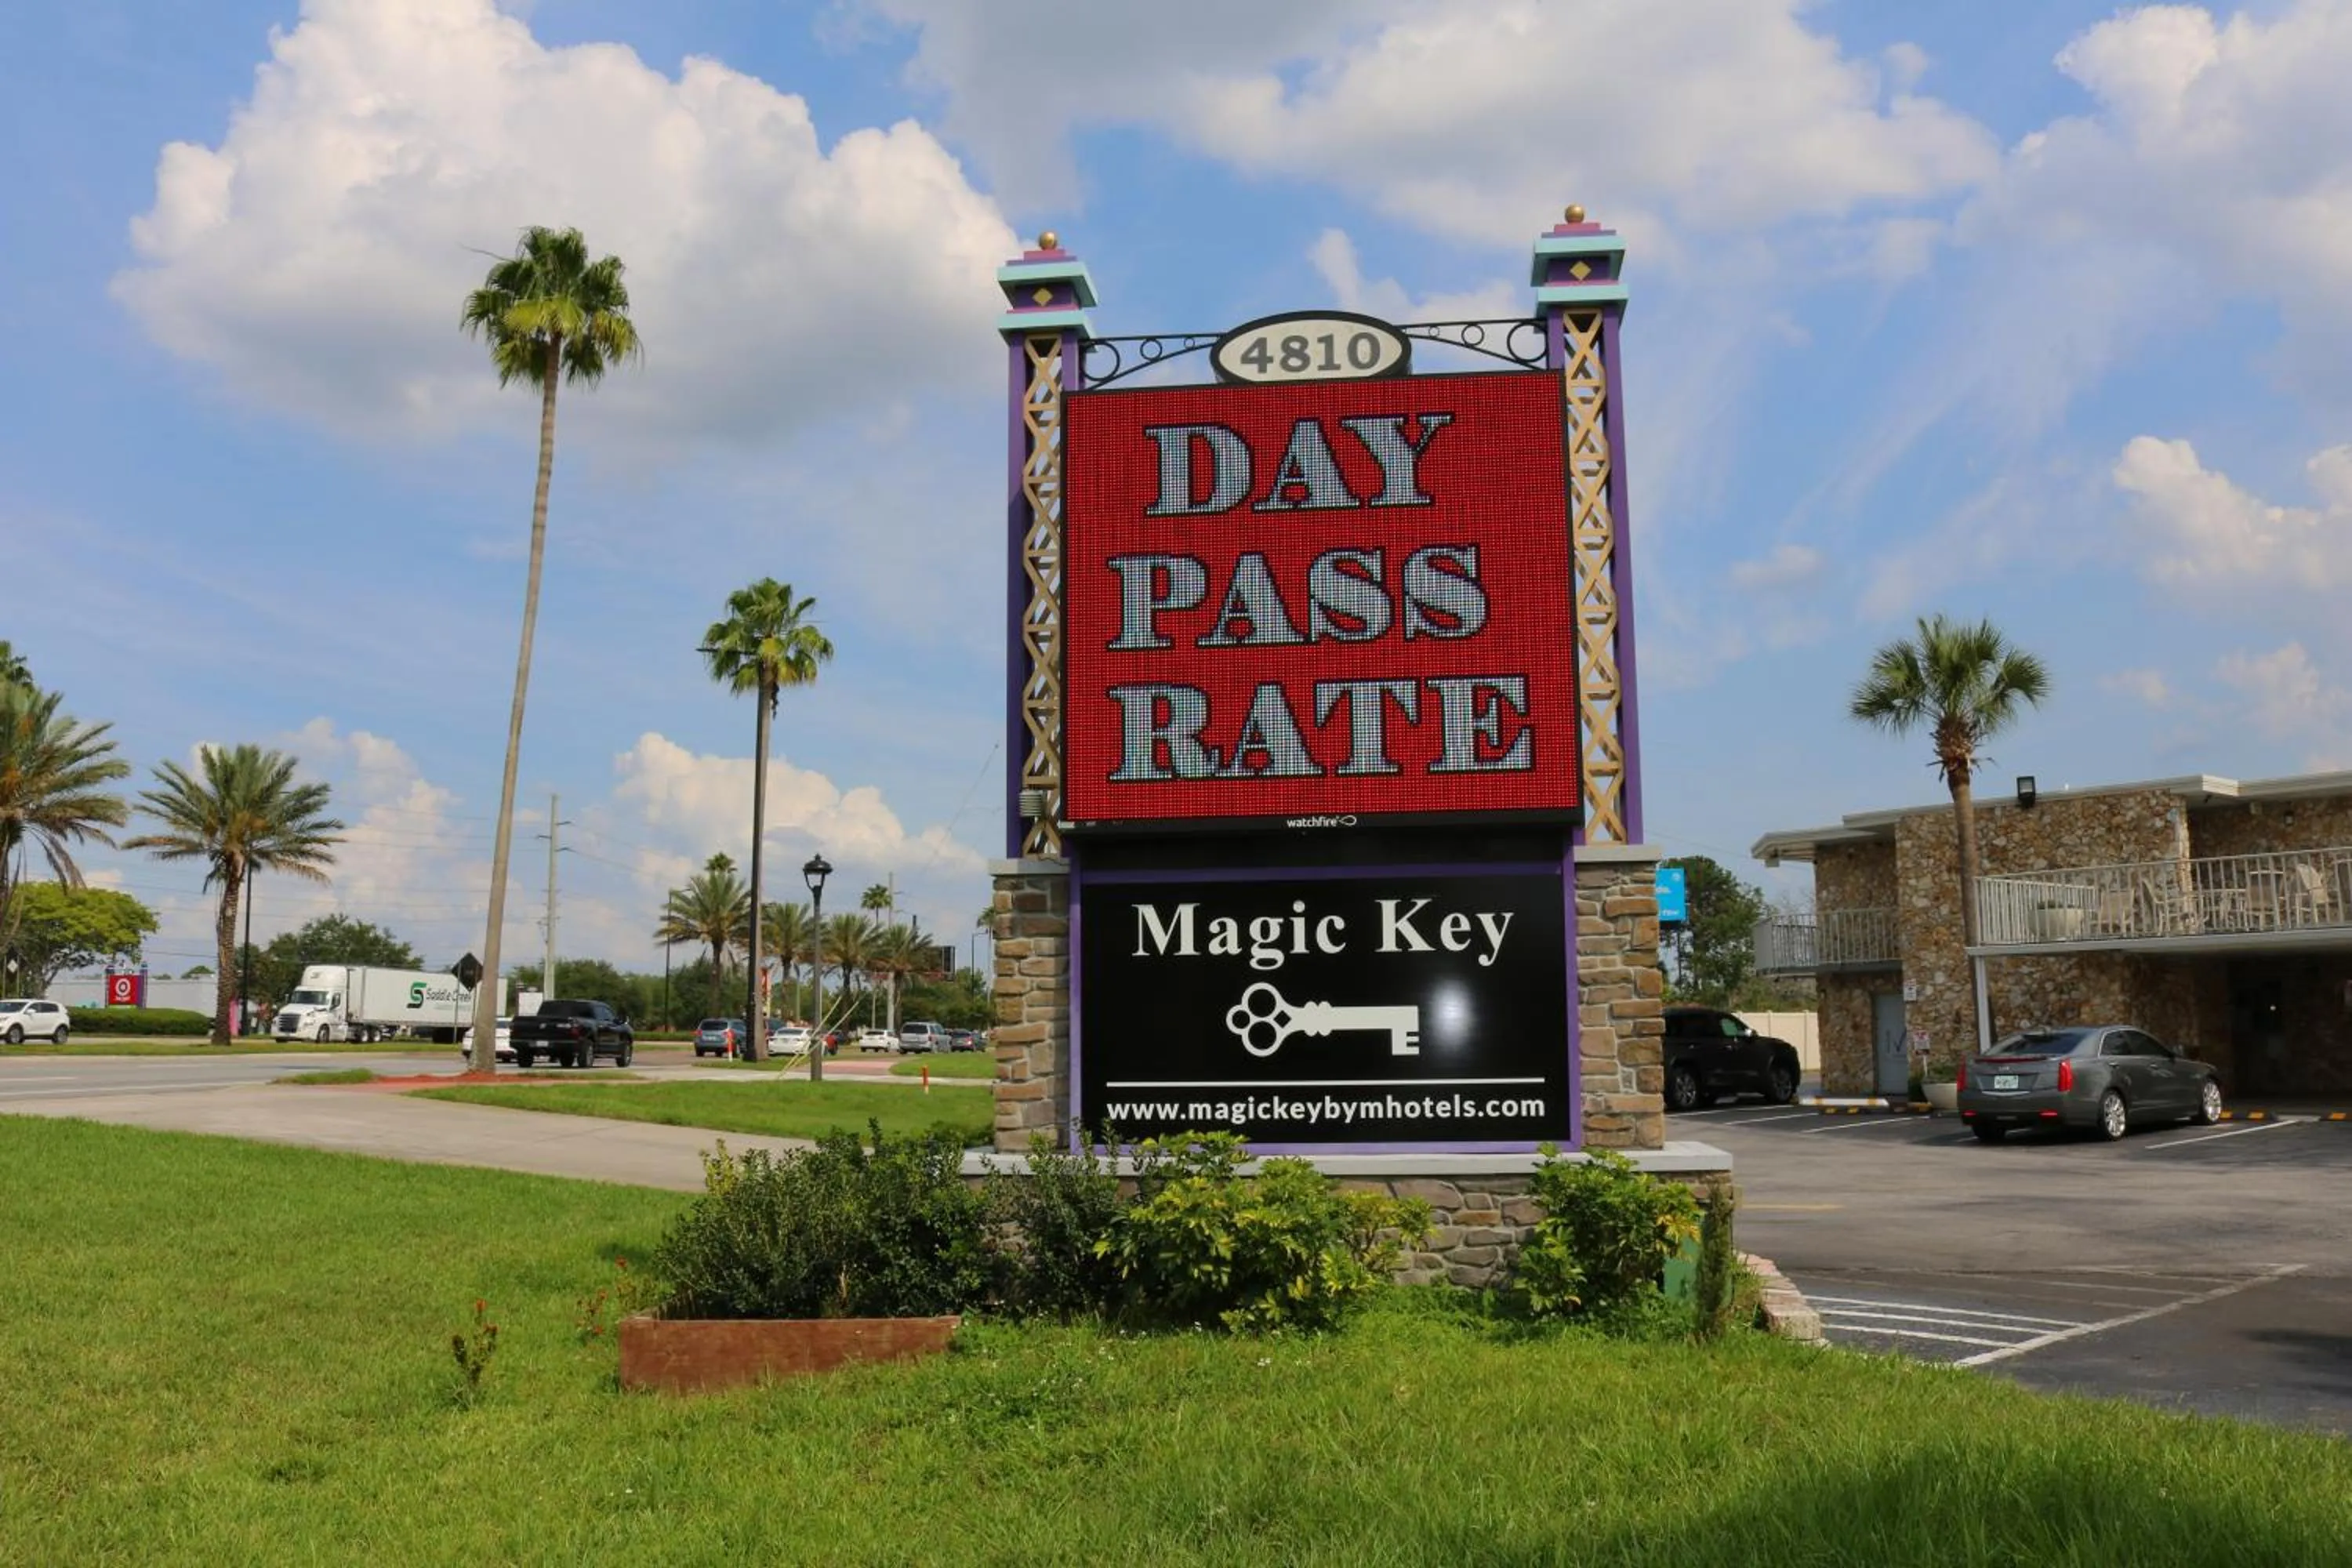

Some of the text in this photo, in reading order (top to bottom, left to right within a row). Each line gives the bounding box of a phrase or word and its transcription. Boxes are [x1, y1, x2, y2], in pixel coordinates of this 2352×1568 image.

[1240, 332, 1381, 374] 4810
[1145, 415, 1454, 517] DAY
[1106, 544, 1488, 650] PASS
[1107, 675, 1534, 783] RATE
[1287, 816, 1338, 828] watchfire
[1132, 899, 1514, 970] Magic Key
[1106, 1094, 1545, 1124] www.magickeybymhotels.com
